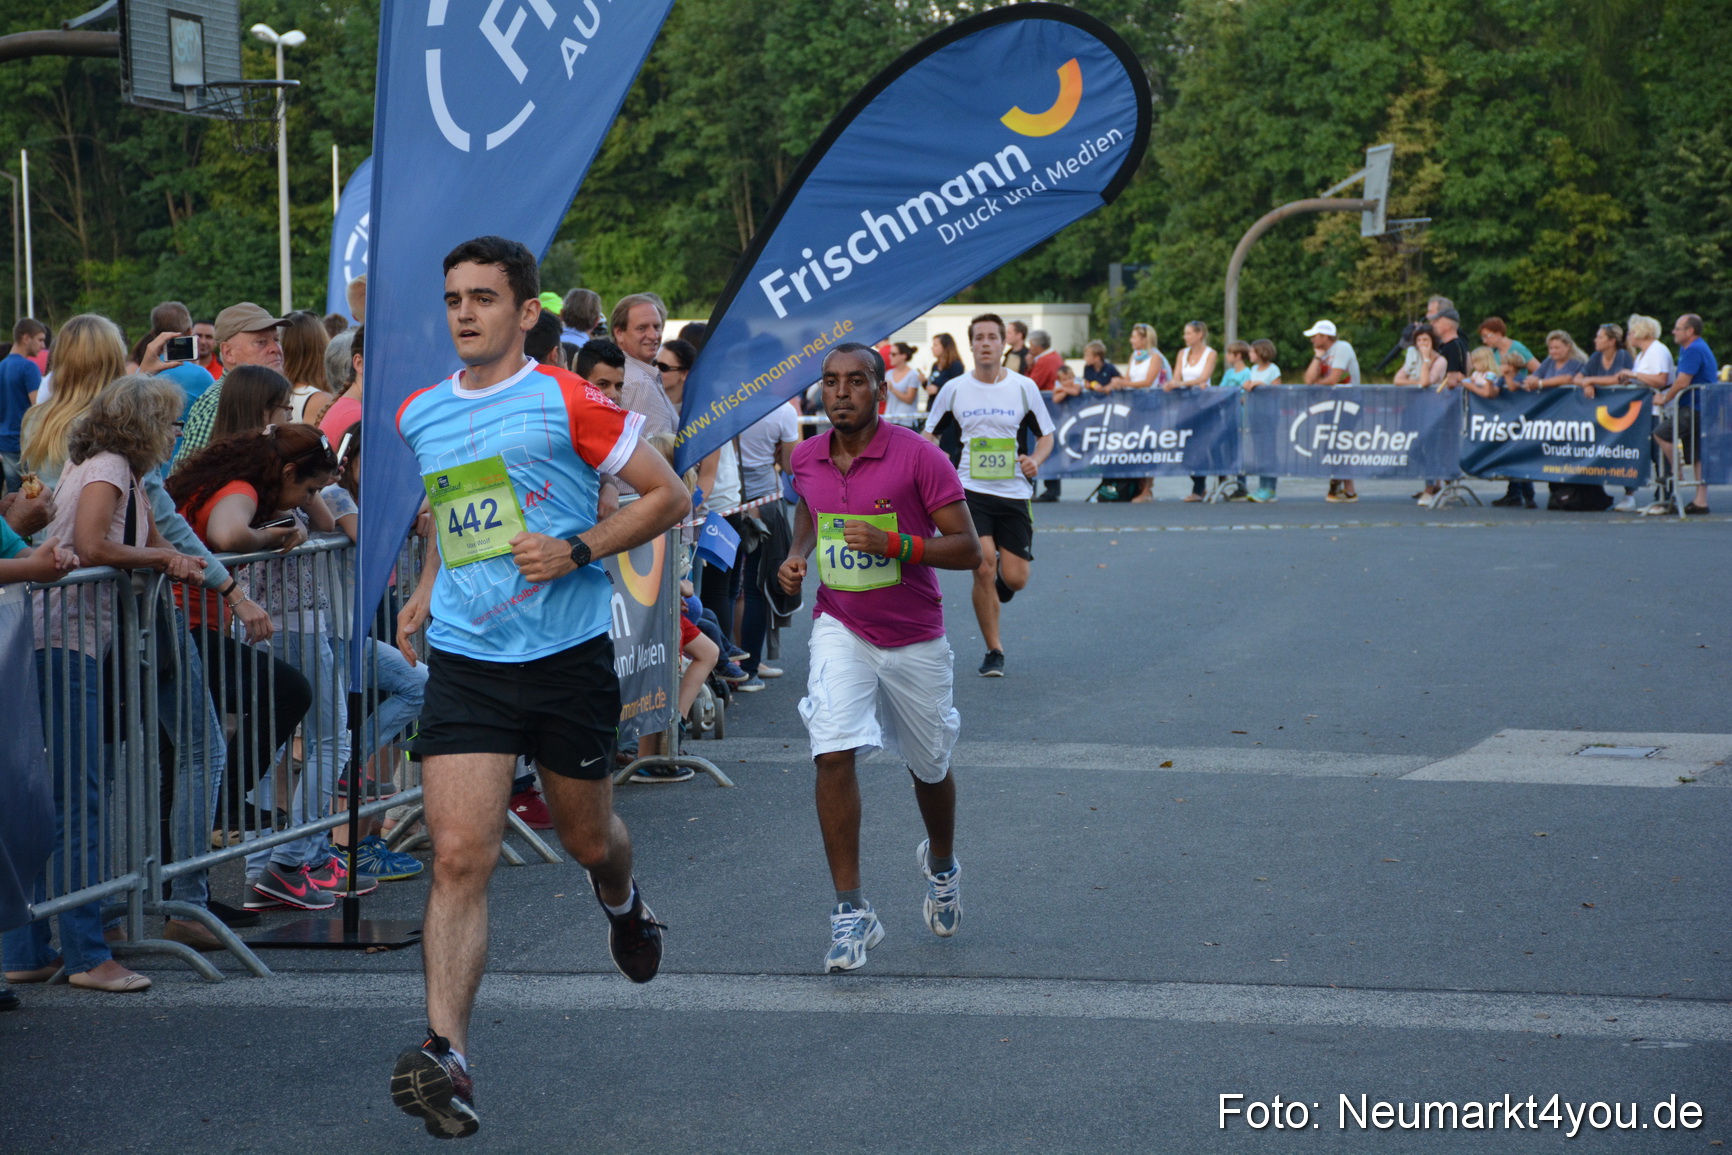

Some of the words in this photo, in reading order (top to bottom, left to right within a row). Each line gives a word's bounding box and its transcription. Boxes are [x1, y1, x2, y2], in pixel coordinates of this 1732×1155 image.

[560, 0, 612, 81] AU
[936, 195, 1003, 245] Druck
[1004, 174, 1048, 205] und
[1045, 127, 1124, 186] Medien
[759, 144, 1032, 319] Frischmann
[673, 319, 855, 448] www.frischmann-net.de
[962, 408, 1015, 418] DELPHI
[1081, 424, 1194, 452] Fischer
[1312, 423, 1420, 451] Fischer
[1470, 413, 1597, 442] Frischmann
[978, 454, 1006, 468] 293
[1090, 451, 1185, 465] AUTOMOBILE
[1321, 453, 1409, 467] AUTOMOBILE
[1542, 442, 1572, 457] Druck
[1573, 444, 1596, 458] und
[1595, 444, 1641, 460] Medien
[448, 498, 503, 537] 442
[477, 537, 491, 546] Wolf
[825, 544, 891, 570] 1659
[636, 638, 666, 673] Meien
